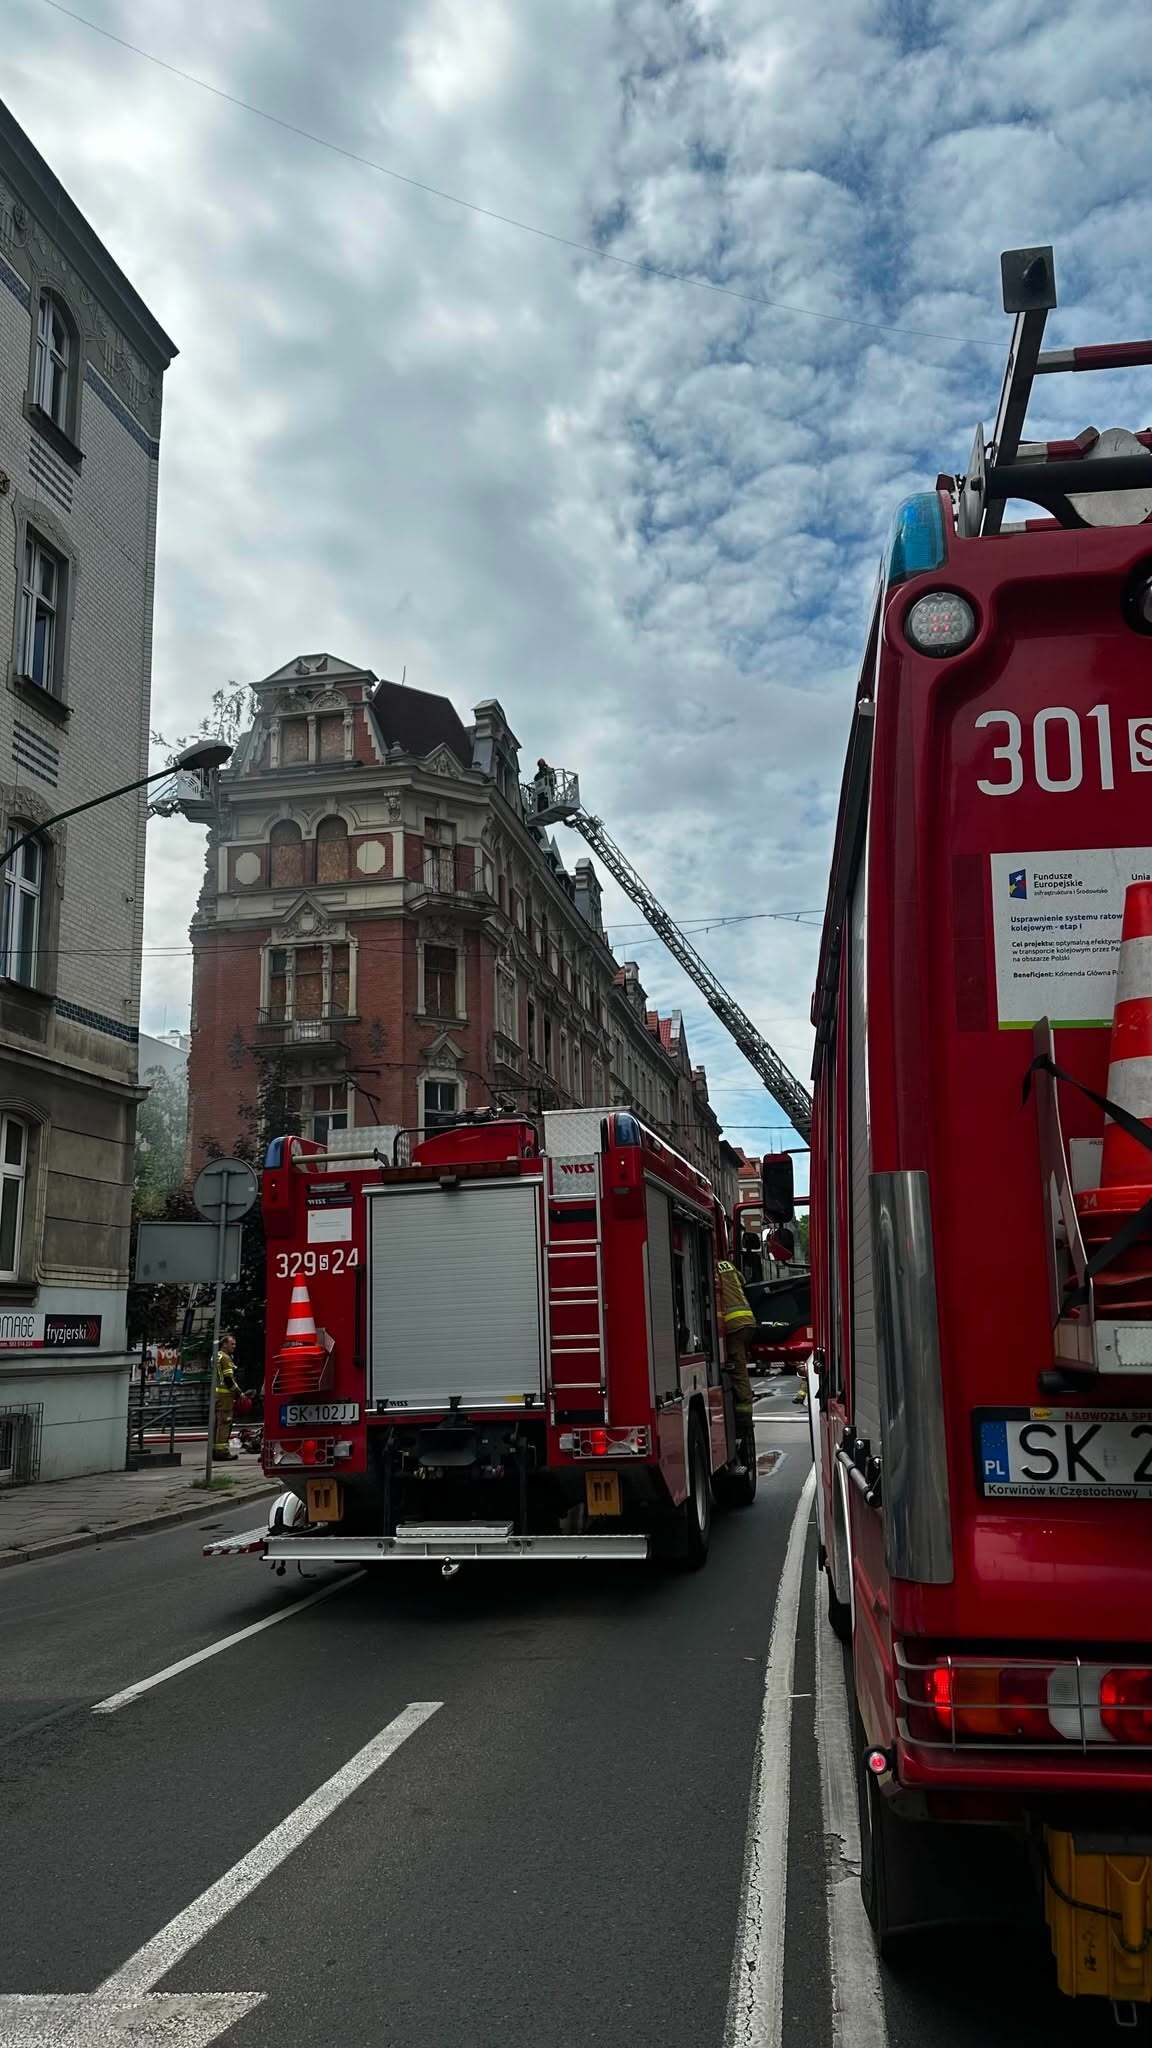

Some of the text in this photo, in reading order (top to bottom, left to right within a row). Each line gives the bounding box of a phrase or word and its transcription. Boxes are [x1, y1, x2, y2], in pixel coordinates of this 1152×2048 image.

[975, 704, 1115, 796] 301
[1034, 880, 1083, 888] Europejskie
[1131, 873, 1151, 881] Unia
[1011, 915, 1063, 923] Usprawnienie
[1011, 924, 1053, 932] kolejowym
[276, 1251, 316, 1278] 329
[332, 1248, 358, 1274] 24
[0, 1316, 35, 1338] MAGE
[47, 1324, 87, 1344] fryzjerski
[289, 1406, 308, 1421] SK
[315, 1405, 356, 1420] 102JJ
[1065, 1411, 1128, 1421] NADWOZIA
[985, 1460, 1006, 1475] PL
[1019, 1423, 1106, 1482] SK
[988, 1484, 1046, 1496] Korwinów
[1049, 1485, 1139, 1498] k/Częstochowy
